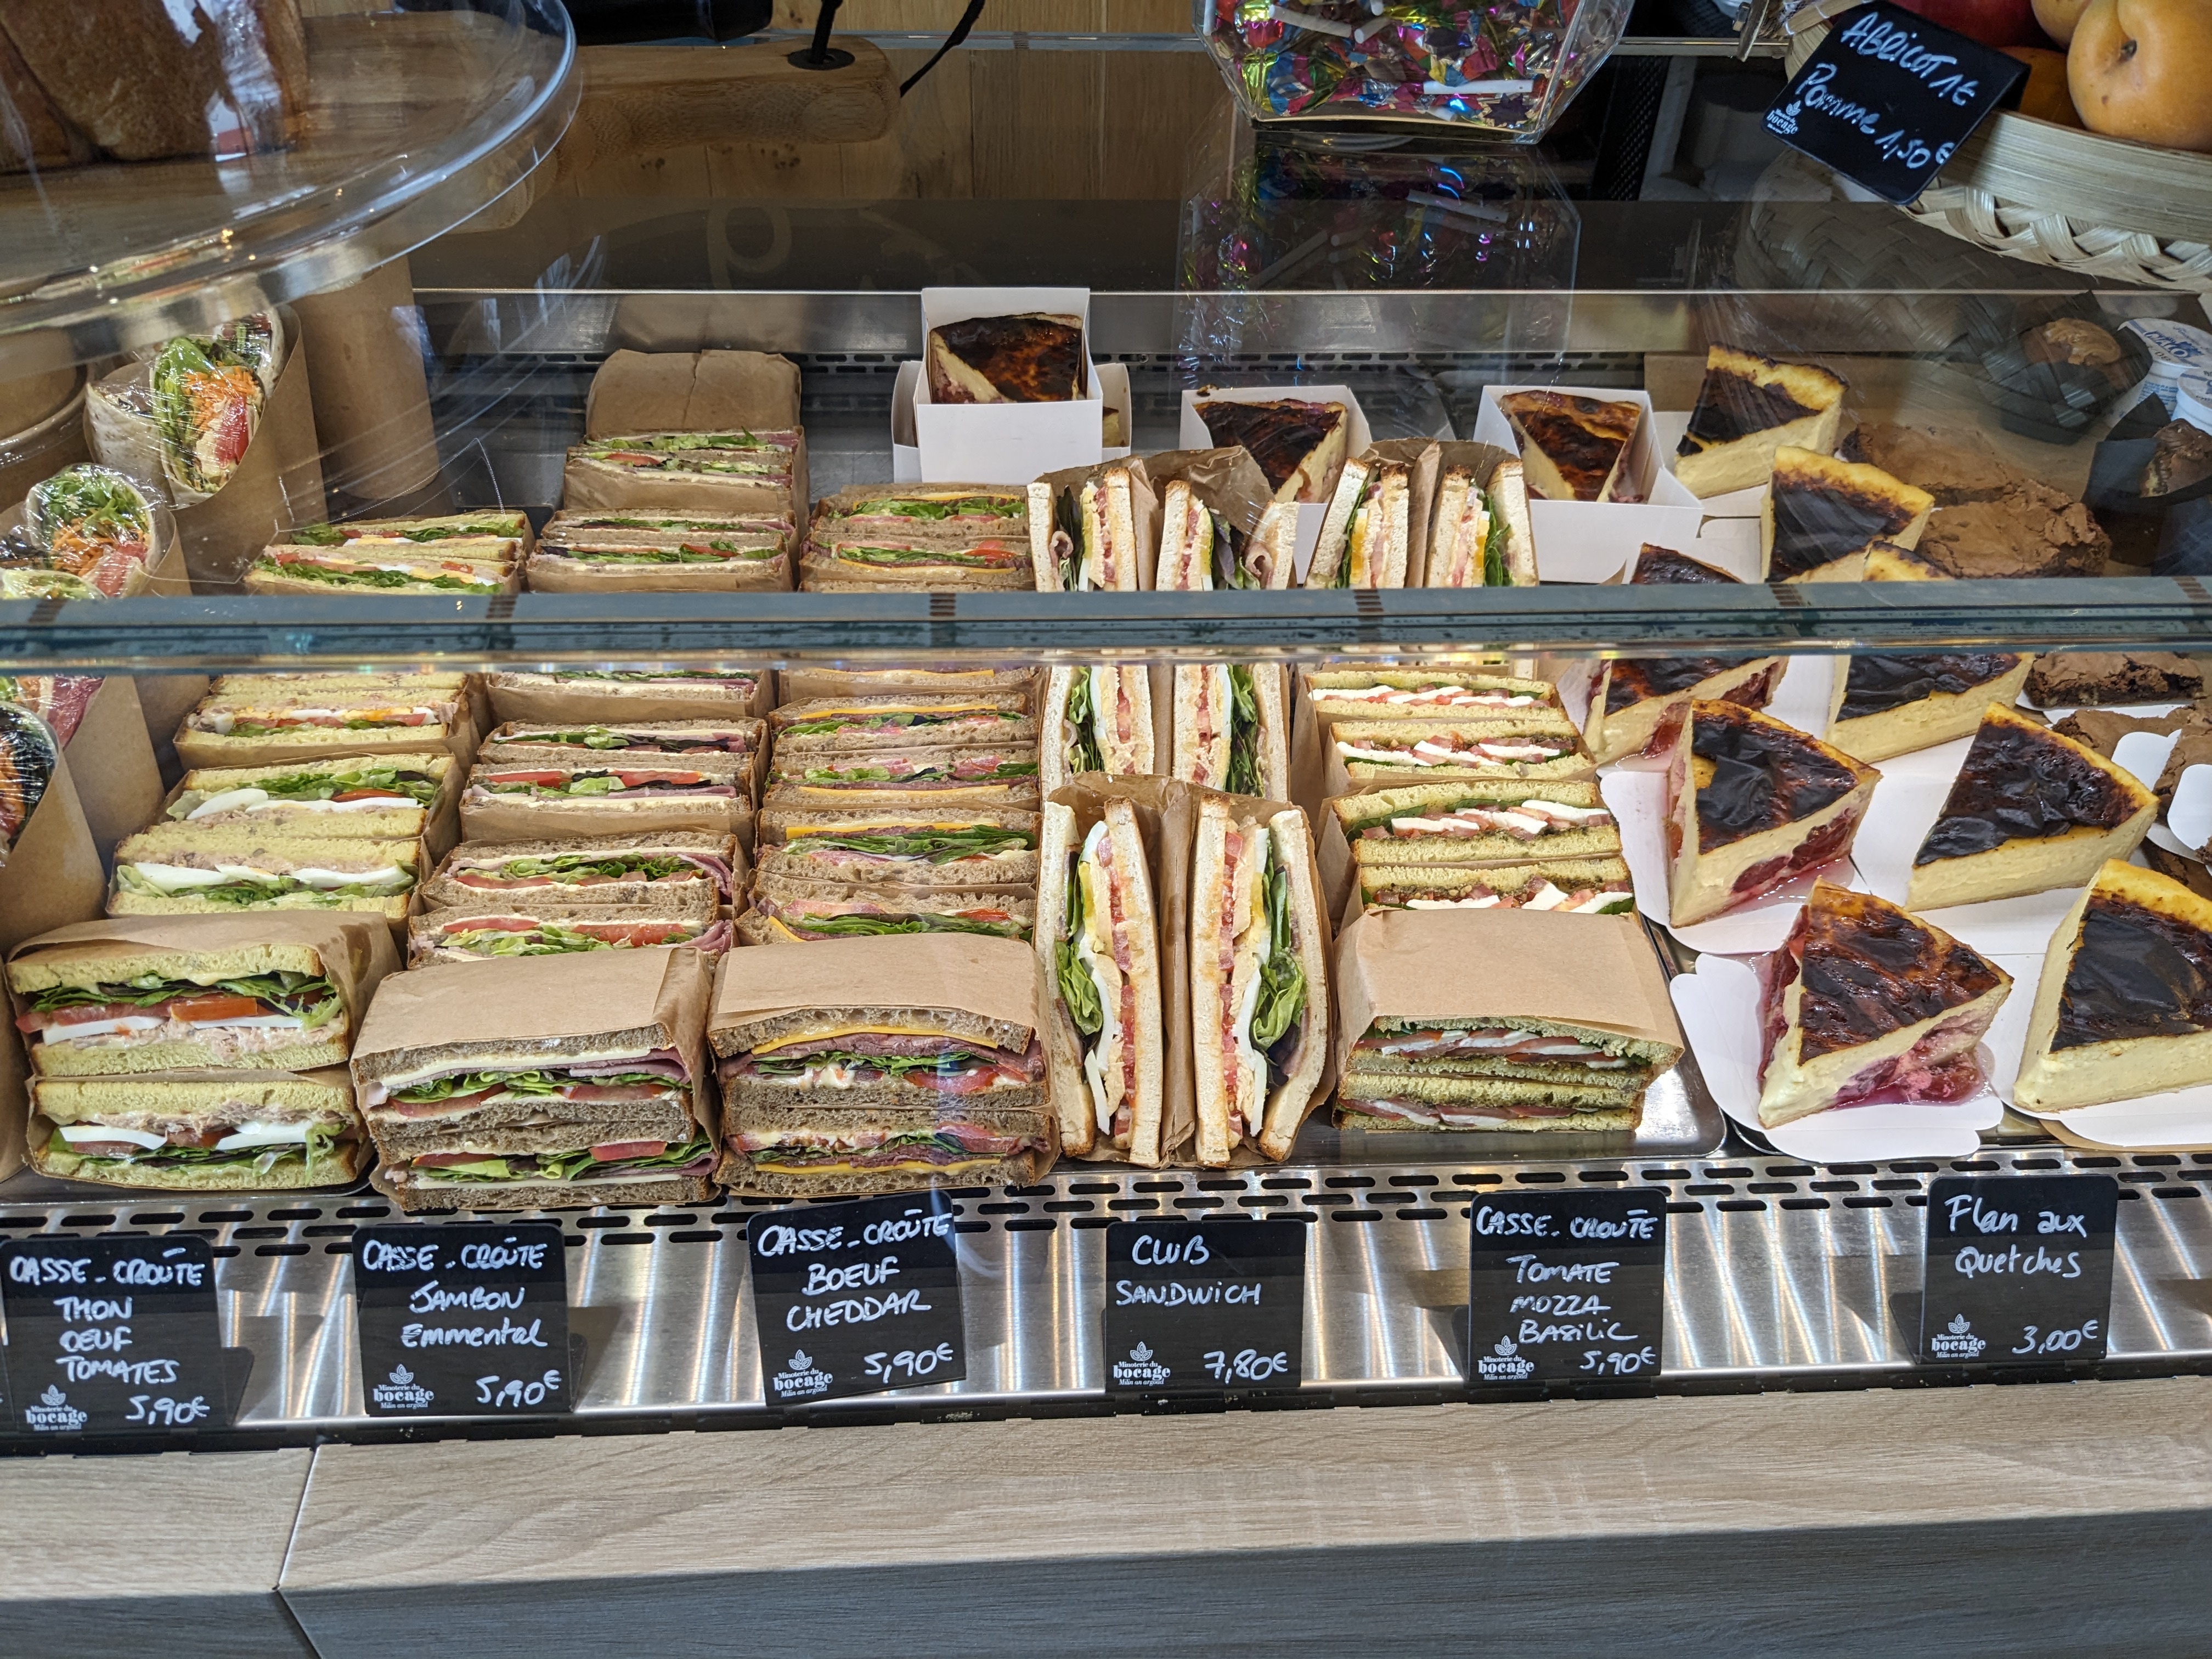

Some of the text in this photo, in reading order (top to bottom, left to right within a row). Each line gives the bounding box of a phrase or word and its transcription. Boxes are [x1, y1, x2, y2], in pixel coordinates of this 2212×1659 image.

[1944, 1194, 2018, 1233] Flan
[802, 1256, 900, 1297] BOEUF
[1505, 1254, 1620, 1284] TOMATE
[53, 1296, 133, 1323] THON
[786, 1288, 932, 1331] CHEDDAR
[59, 1325, 133, 1352] OEUF
[400, 1317, 548, 1347] Emmental
[1932, 1338, 1986, 1353] bocage
[2012, 1319, 2098, 1354] 3,00€
[55, 1355, 180, 1385] TOMATES
[864, 1342, 953, 1384] 5,90€
[1113, 1365, 1171, 1381] bocage
[1203, 1348, 1288, 1384] 7,80€
[1477, 1359, 1534, 1375] bocage
[1579, 1346, 1656, 1375] 5,90€
[373, 1388, 434, 1404] bocage
[476, 1369, 562, 1407] 5,90€
[772, 1372, 833, 1391] bocage
[25, 1409, 88, 1426] bocage
[125, 1395, 210, 1425] 5,90€
